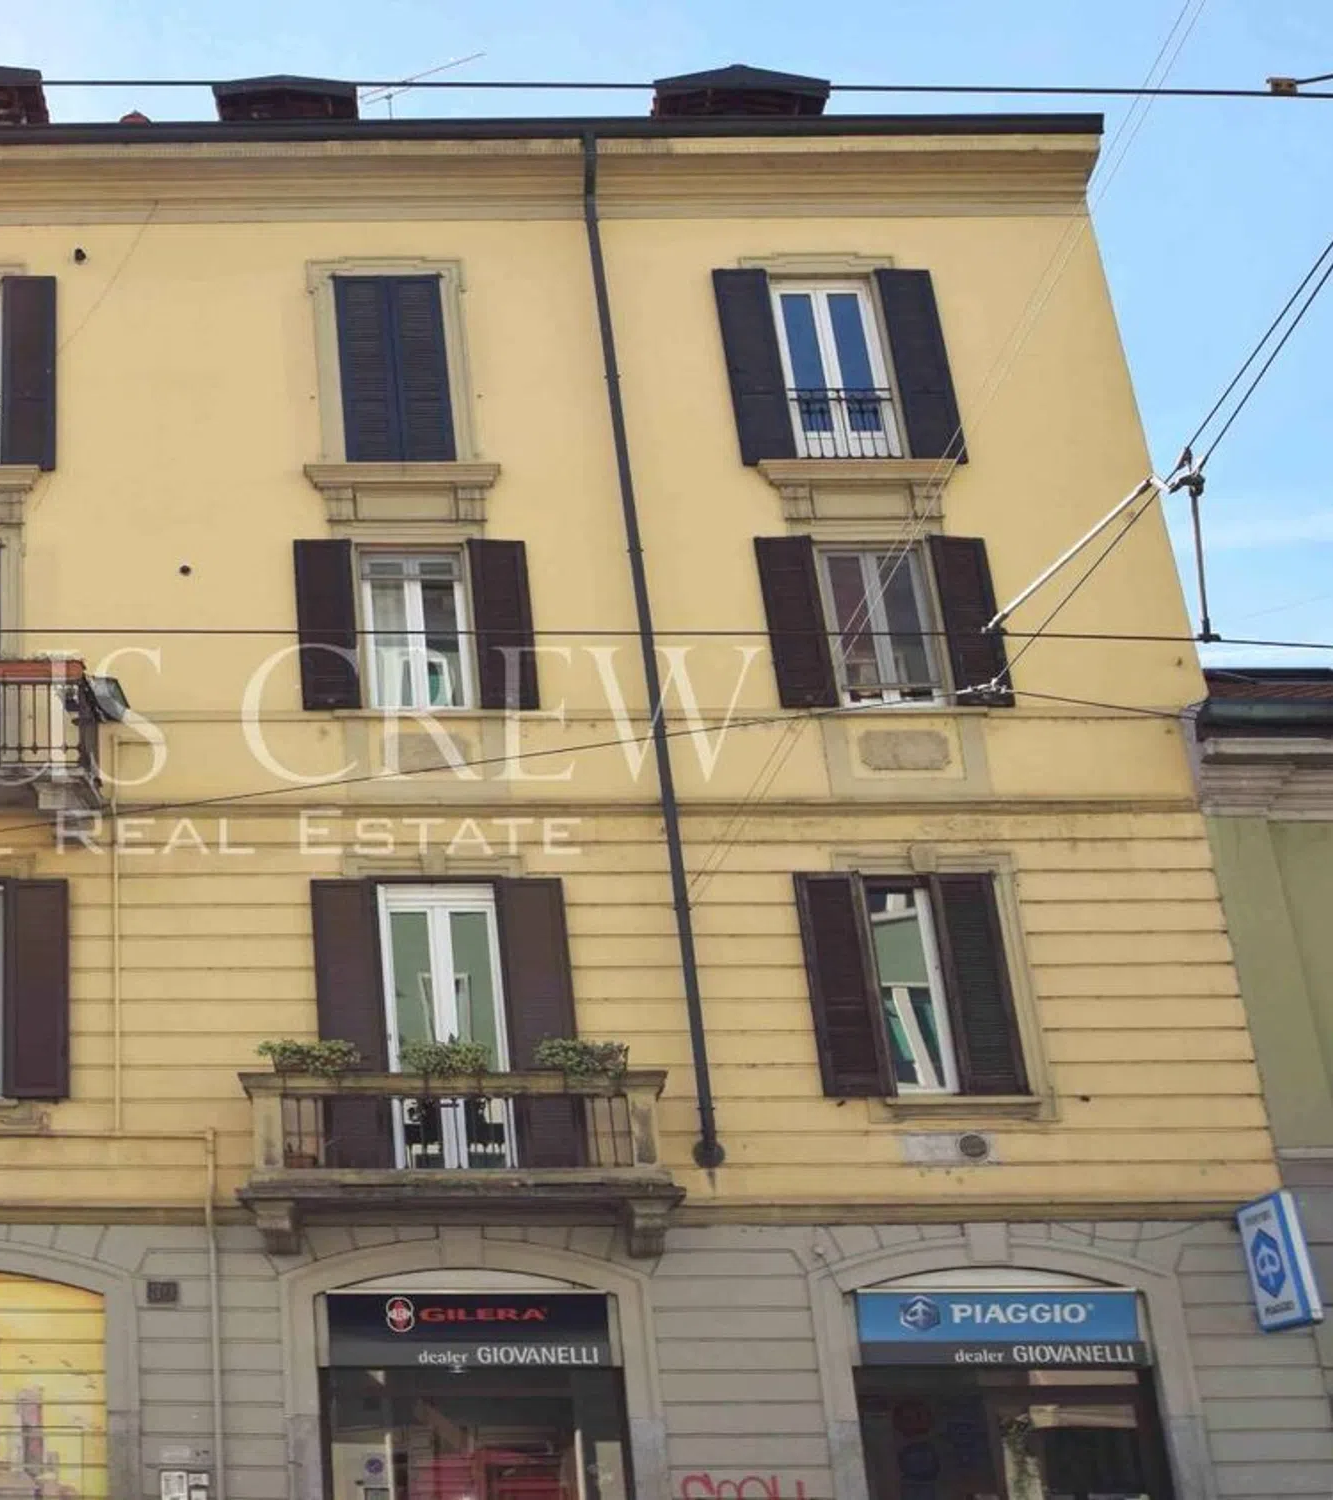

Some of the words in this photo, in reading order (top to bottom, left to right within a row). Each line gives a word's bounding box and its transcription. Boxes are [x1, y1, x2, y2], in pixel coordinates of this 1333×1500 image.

[419, 1307, 547, 1321] GILERA
[950, 1303, 1087, 1324] PIAGGIO
[418, 1350, 468, 1365] dealer
[477, 1347, 599, 1364] GIOVANELLI
[954, 1349, 1005, 1363] dealer
[1012, 1345, 1135, 1363] GIOVANELLI
